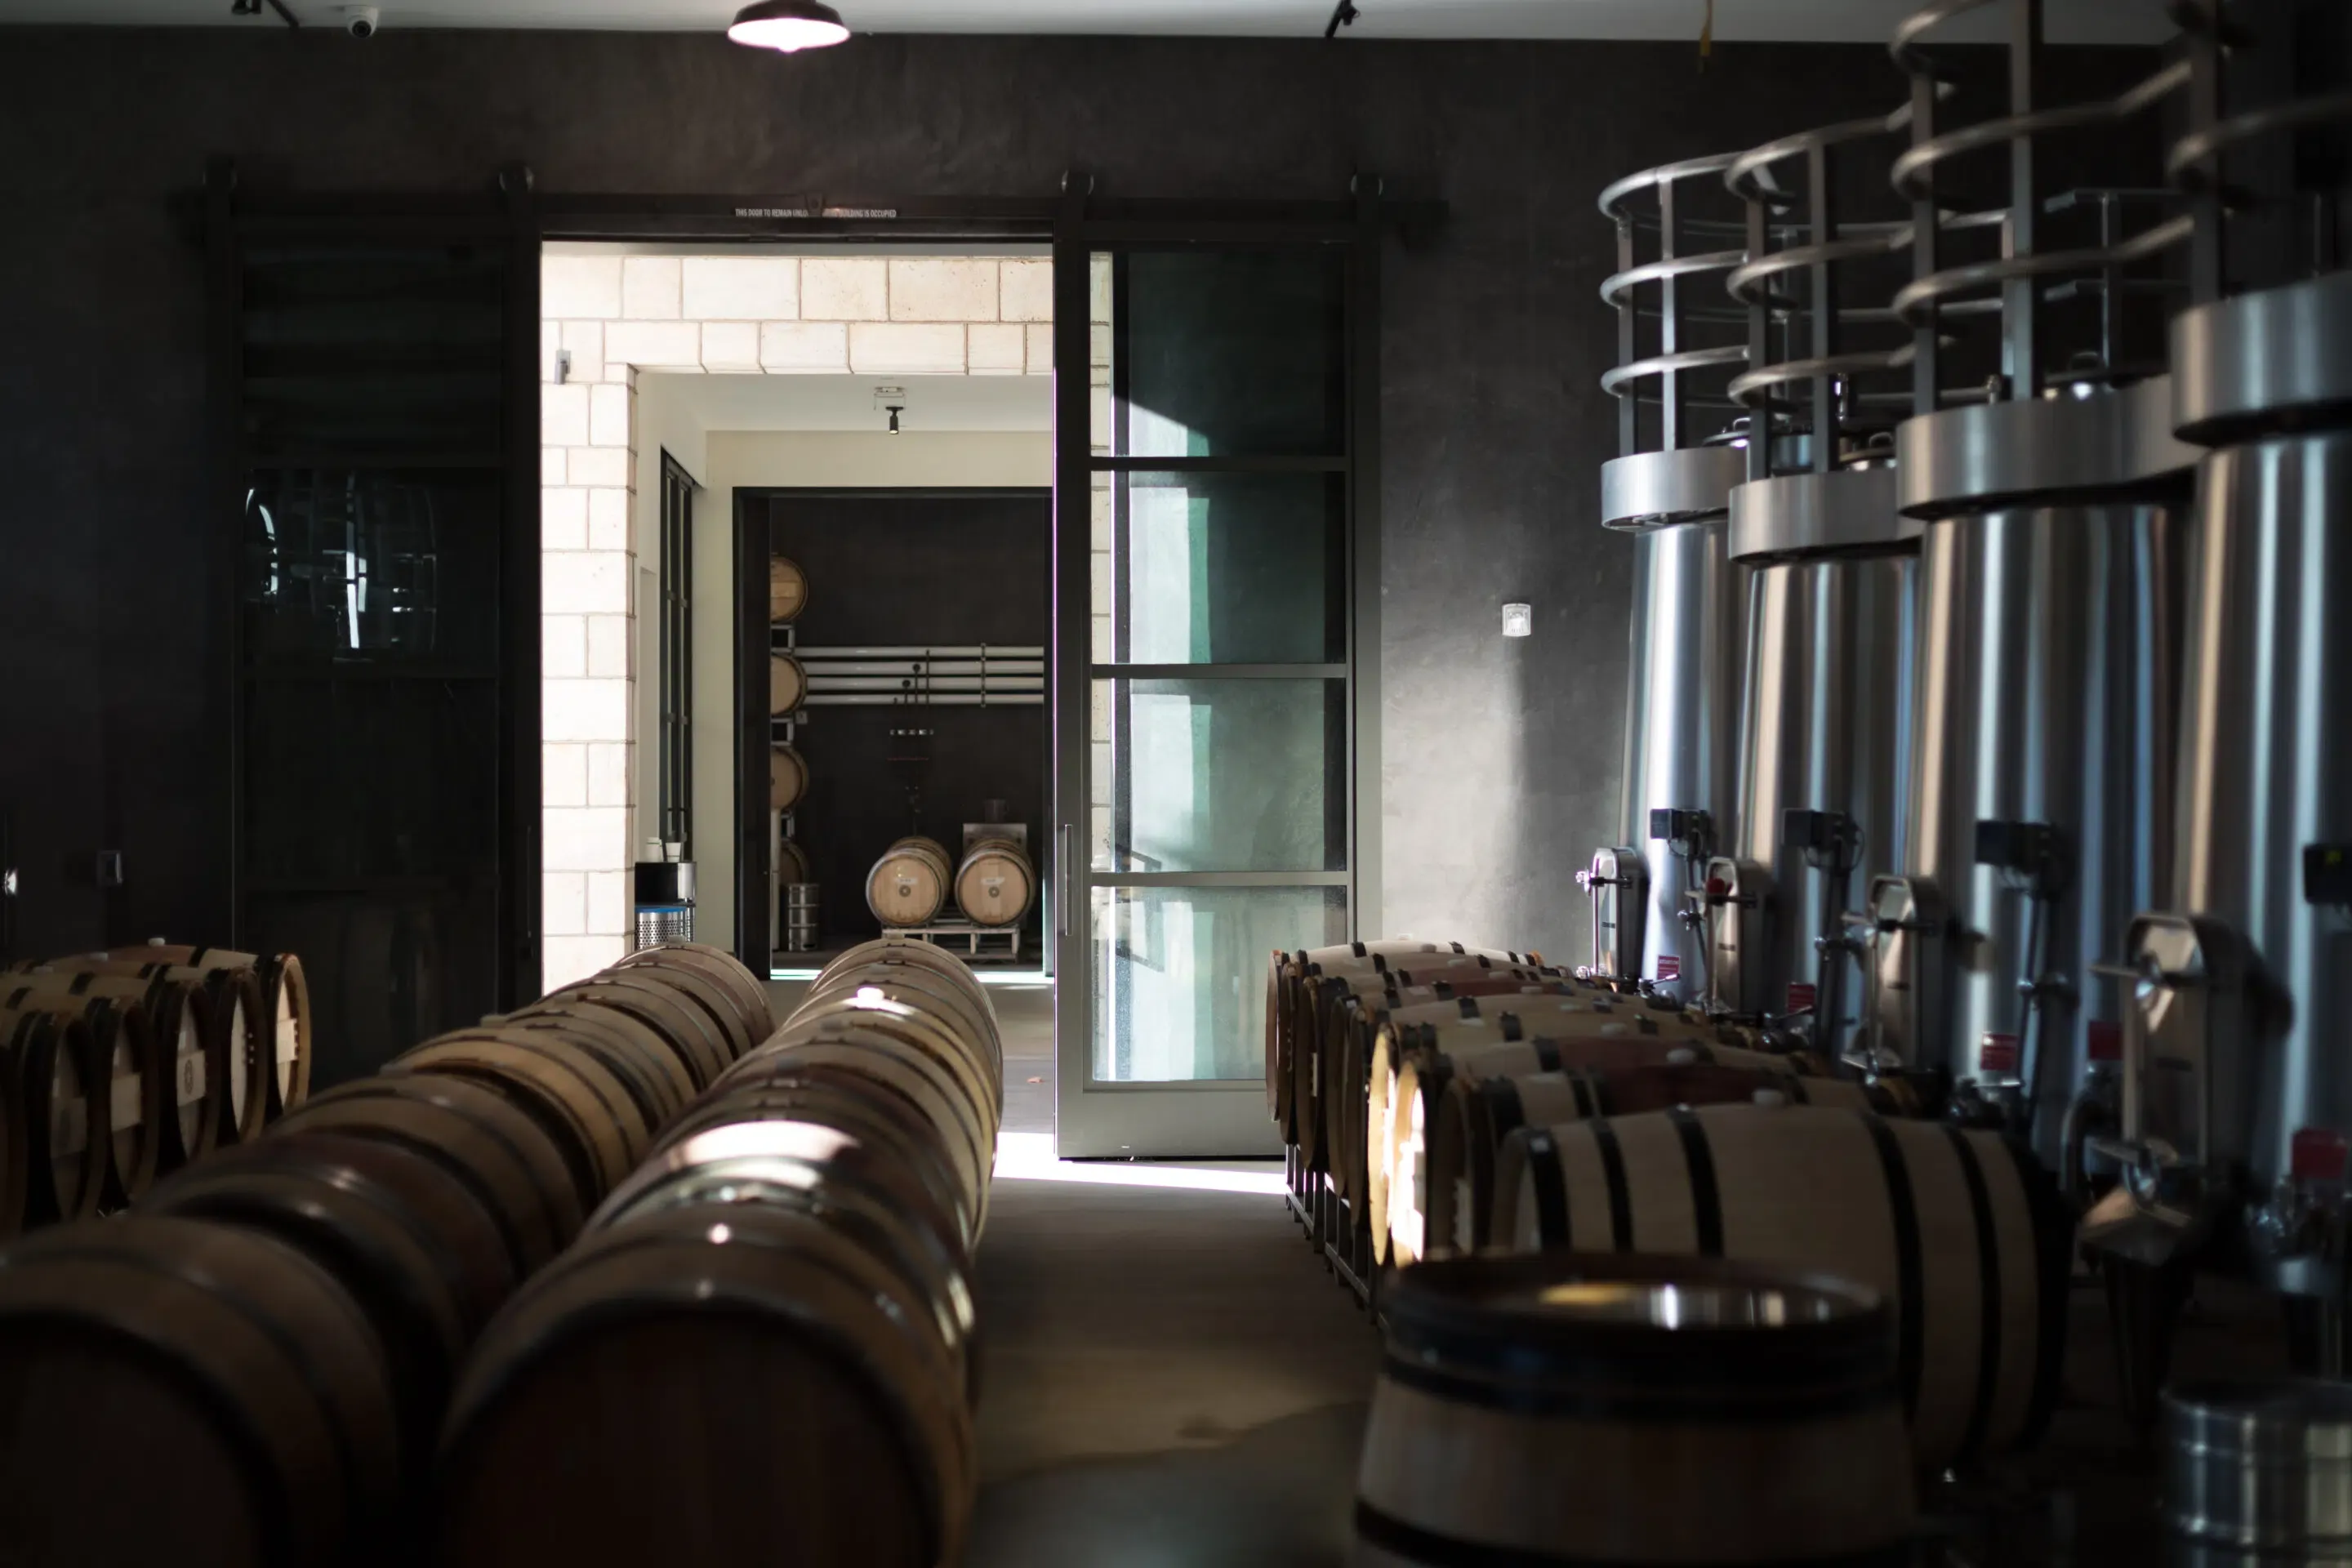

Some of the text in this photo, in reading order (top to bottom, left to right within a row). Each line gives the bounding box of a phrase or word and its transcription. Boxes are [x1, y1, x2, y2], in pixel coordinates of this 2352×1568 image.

[735, 209, 746, 217] THIS
[748, 209, 762, 217] DOOR
[764, 209, 771, 217] TO
[772, 209, 791, 217] REMAIN
[865, 209, 870, 218] IS
[871, 209, 897, 218] OCCUPIED
